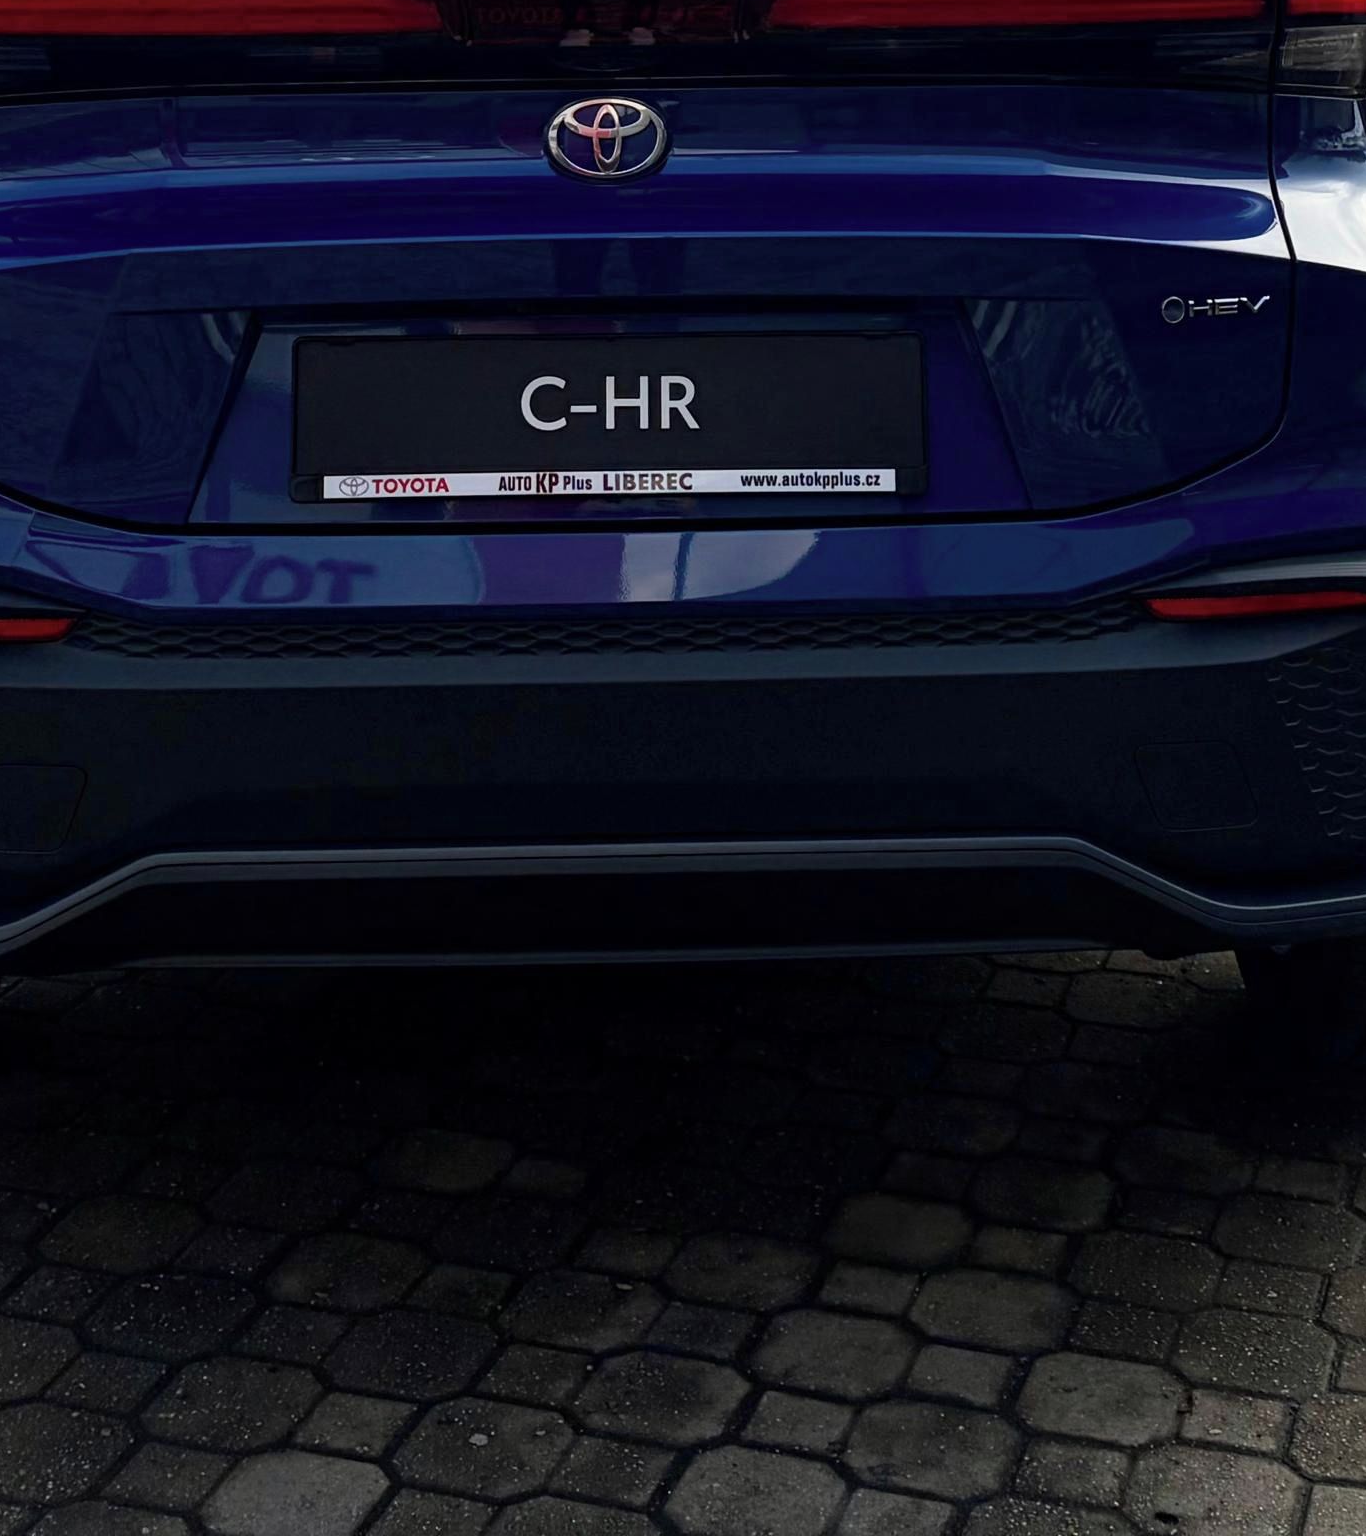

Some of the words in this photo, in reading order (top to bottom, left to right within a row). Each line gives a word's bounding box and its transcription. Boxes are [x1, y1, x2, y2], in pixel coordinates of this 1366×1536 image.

[1187, 295, 1271, 319] HEV
[520, 374, 701, 432] C-HR
[371, 477, 450, 494] TOYOTA
[498, 475, 532, 491] AUTO
[535, 472, 559, 493] KP
[563, 475, 593, 490] Plus
[603, 473, 693, 491] LIBEREC
[740, 471, 881, 490] www.autokpplus.cz
